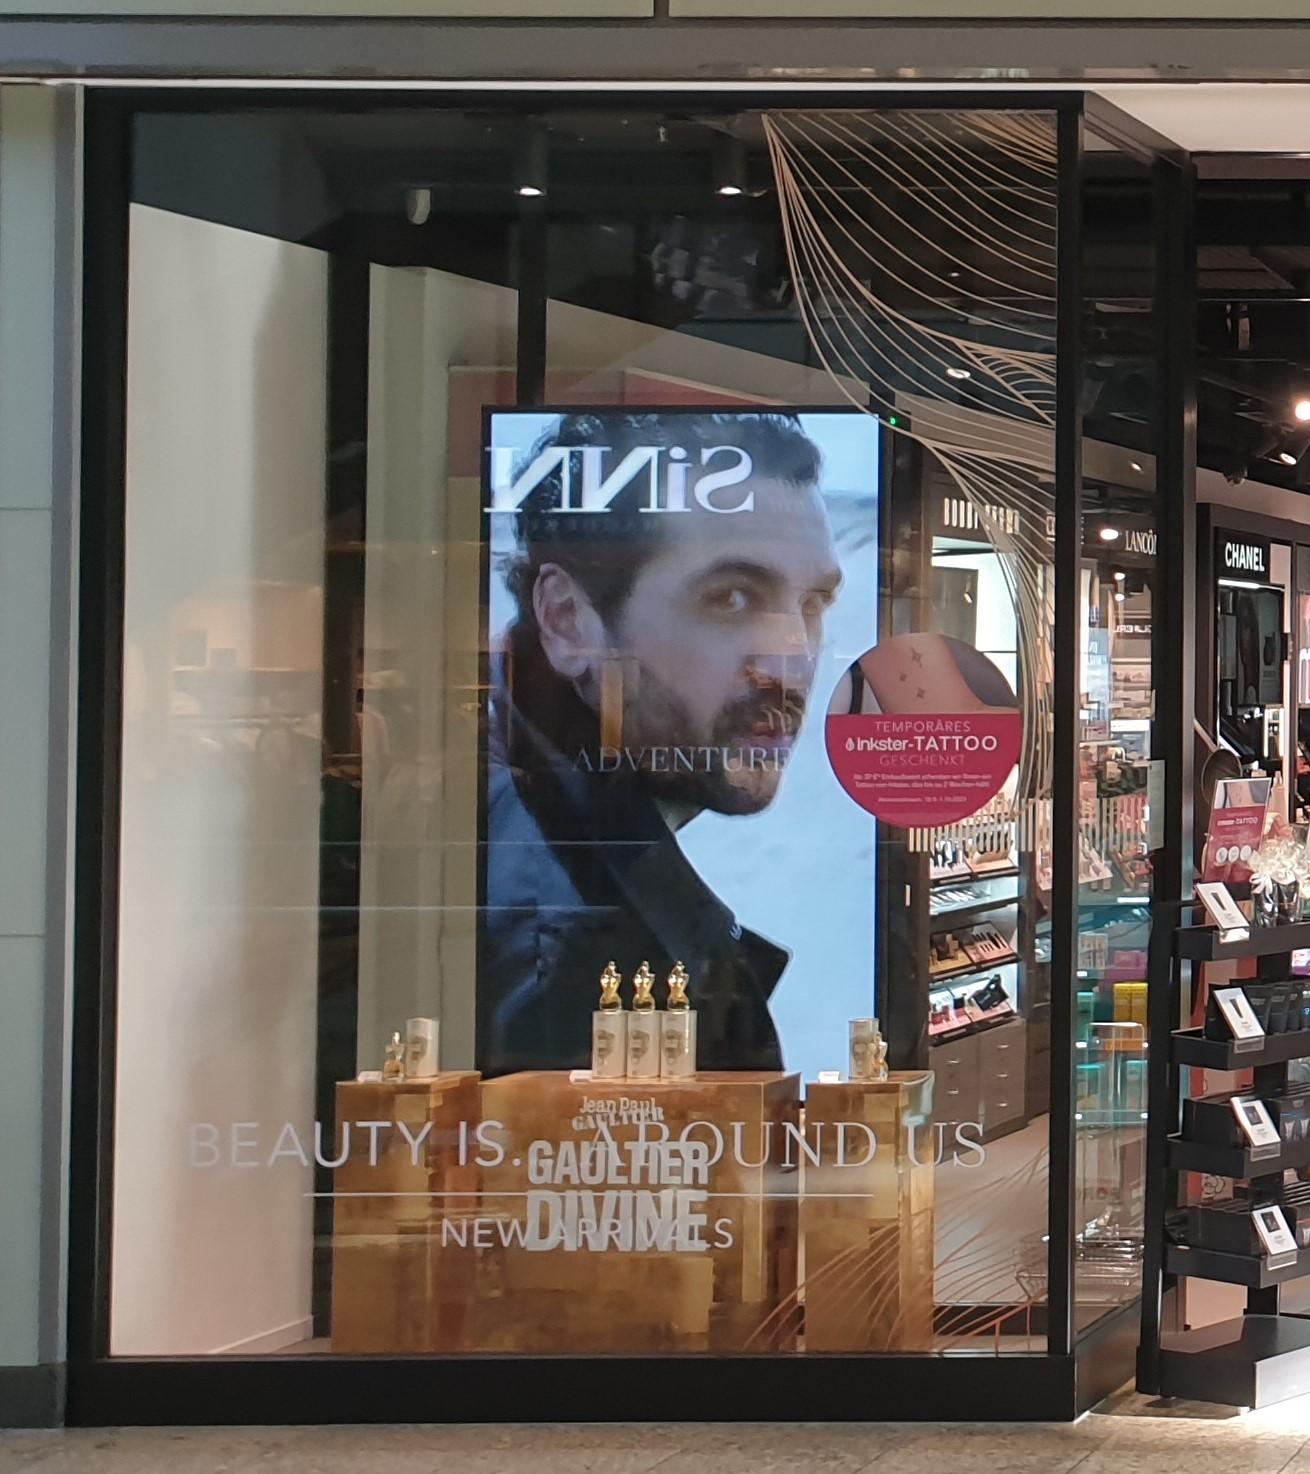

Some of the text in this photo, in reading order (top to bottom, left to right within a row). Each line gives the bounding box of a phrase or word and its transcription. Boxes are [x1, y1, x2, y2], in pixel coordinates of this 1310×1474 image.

[1125, 529, 1158, 555] LANCÔ
[1225, 542, 1265, 572] CHANEL
[879, 755, 965, 767] GESCHENKT
[579, 1096, 657, 1117] Jean Paul
[188, 1120, 434, 1168] BEAUTY
[579, 1120, 878, 1169] AROUND
[906, 1120, 986, 1169] US
[527, 1140, 709, 1184] GAULTIER
[441, 1218, 530, 1248] NEW
[526, 1188, 709, 1251] DIVINE
